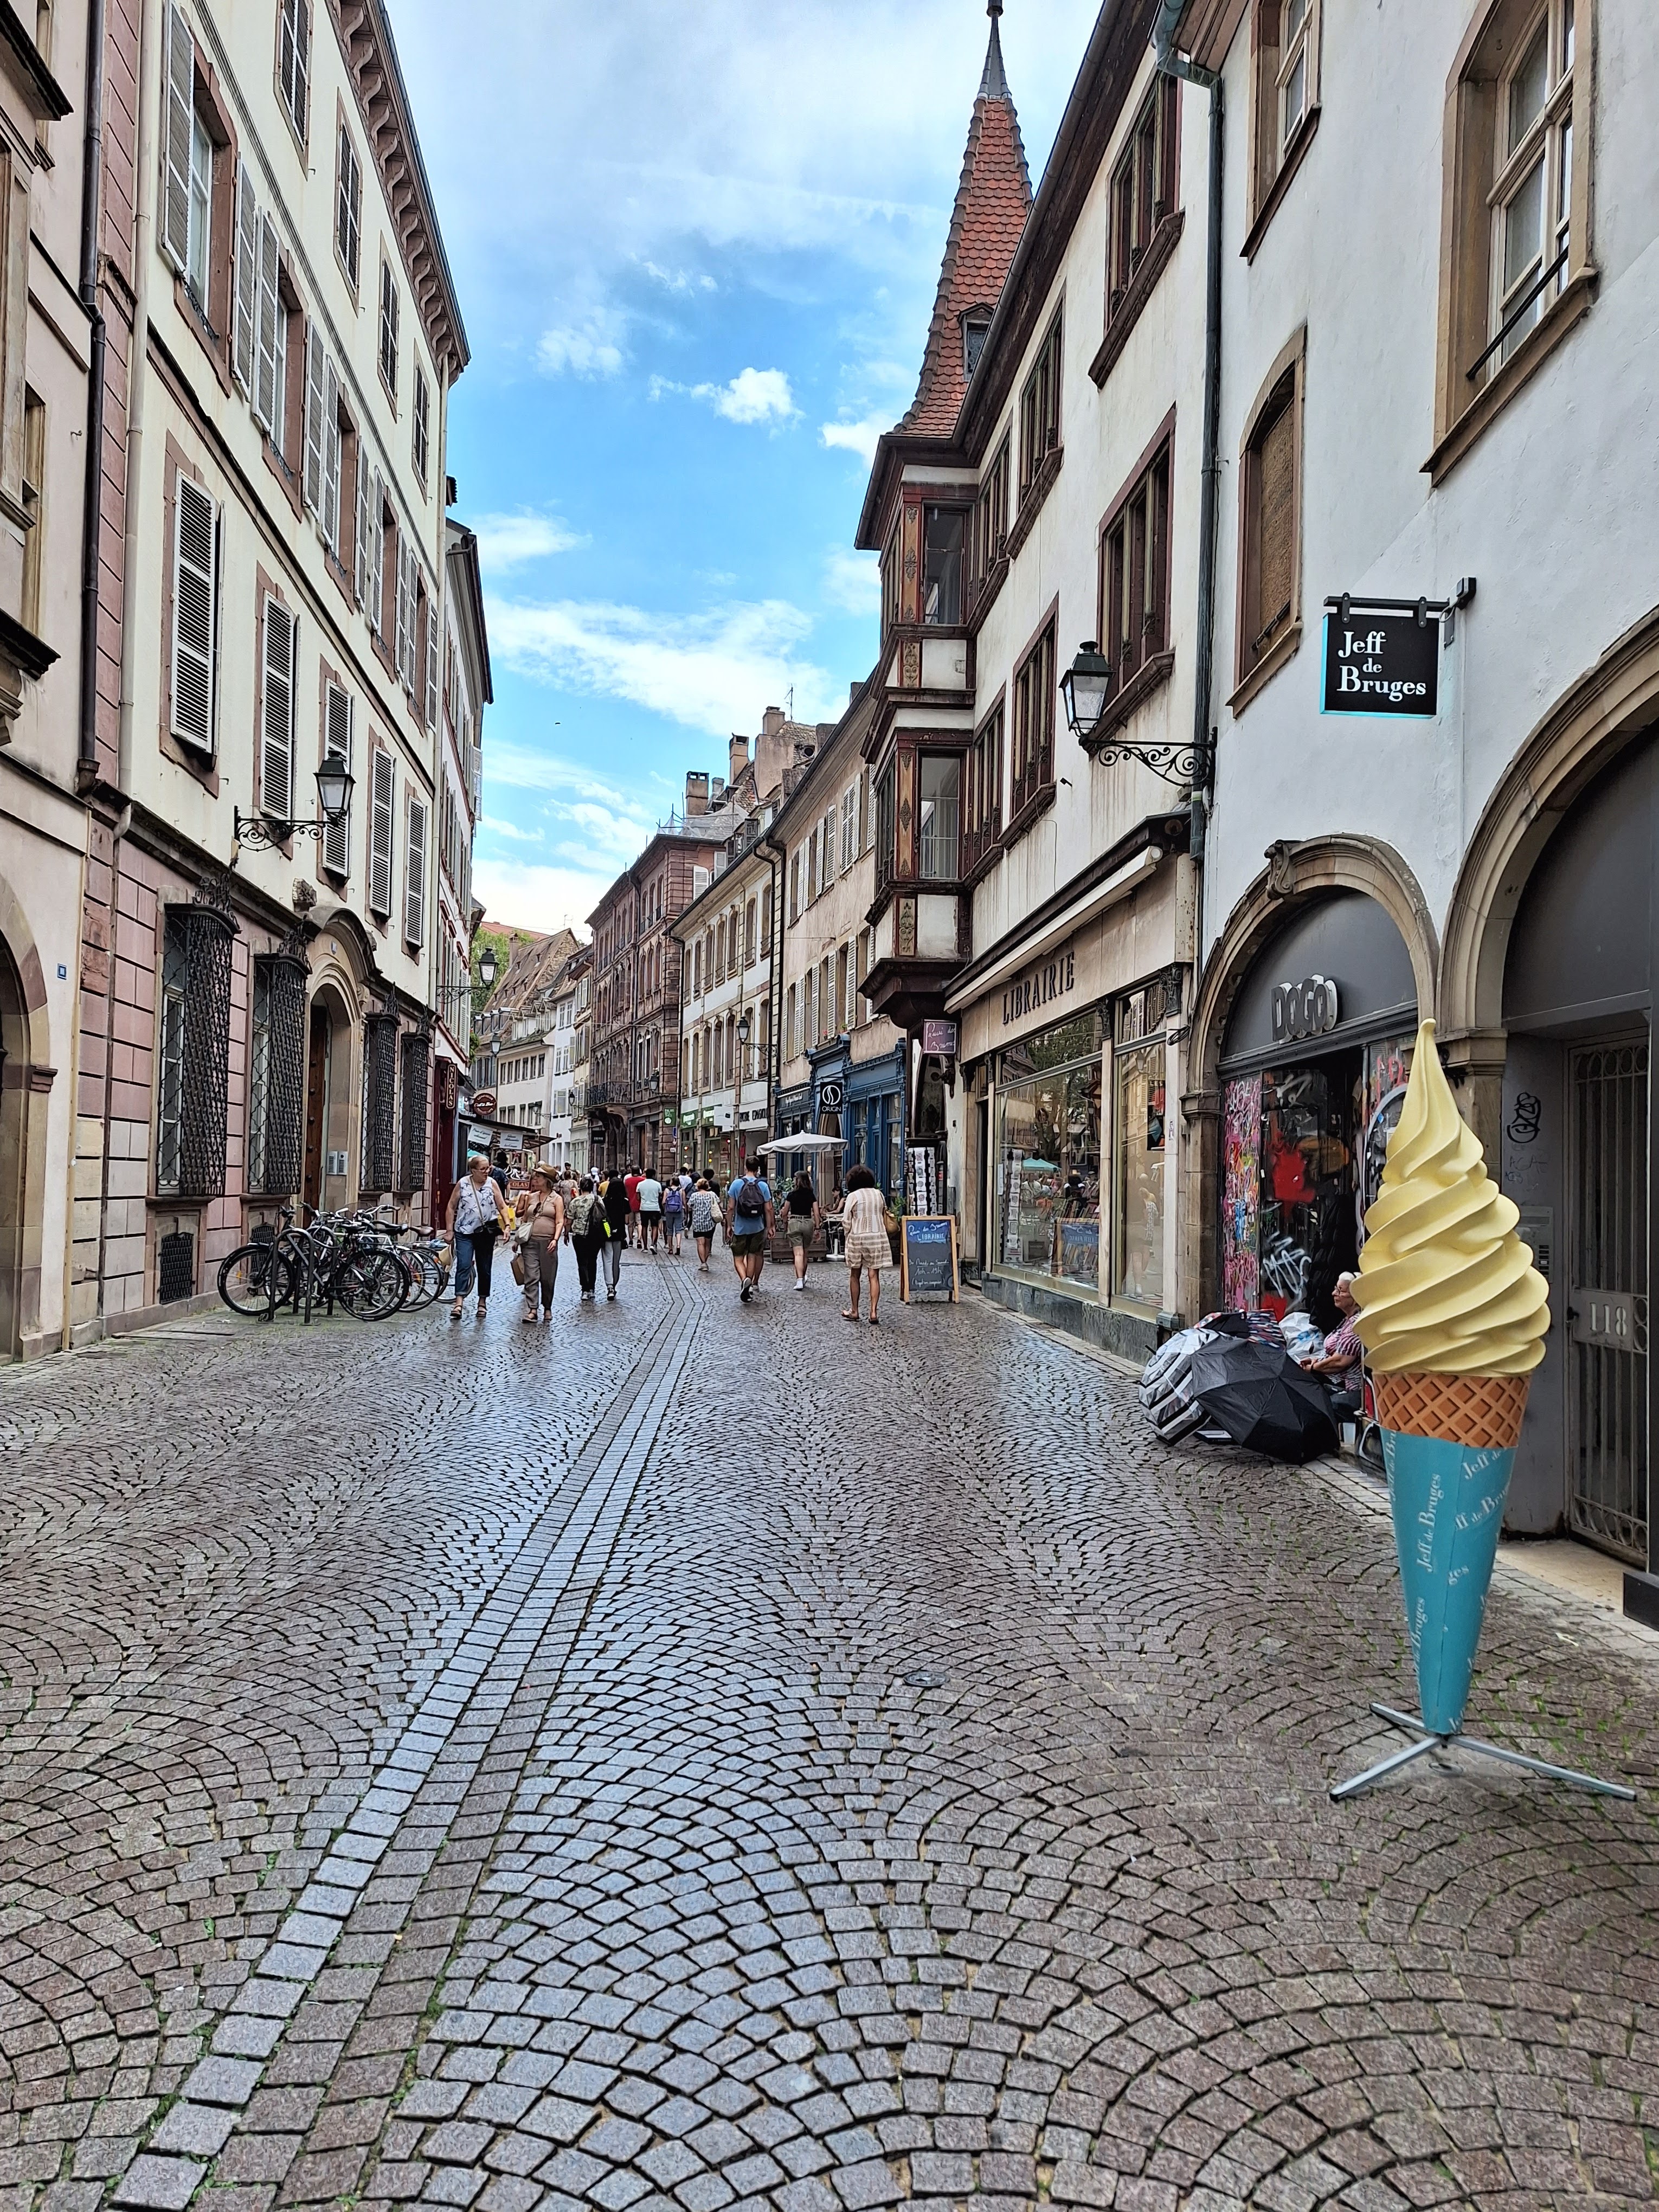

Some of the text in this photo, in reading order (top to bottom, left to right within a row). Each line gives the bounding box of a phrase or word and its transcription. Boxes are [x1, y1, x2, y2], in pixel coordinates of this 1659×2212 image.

[1338, 631, 1387, 658] Jeff
[1362, 658, 1382, 673] de
[1336, 665, 1426, 702] Bruges
[1002, 950, 1075, 1025] LIBRAIRIE
[1270, 974, 1338, 1044] DOGO
[1590, 1302, 1627, 1336] 118
[1463, 1451, 1490, 1480] Jeff
[1418, 1473, 1445, 1528] Bruges
[1417, 1539, 1433, 1573] Jeff
[1411, 1597, 1429, 1649] Bruges
